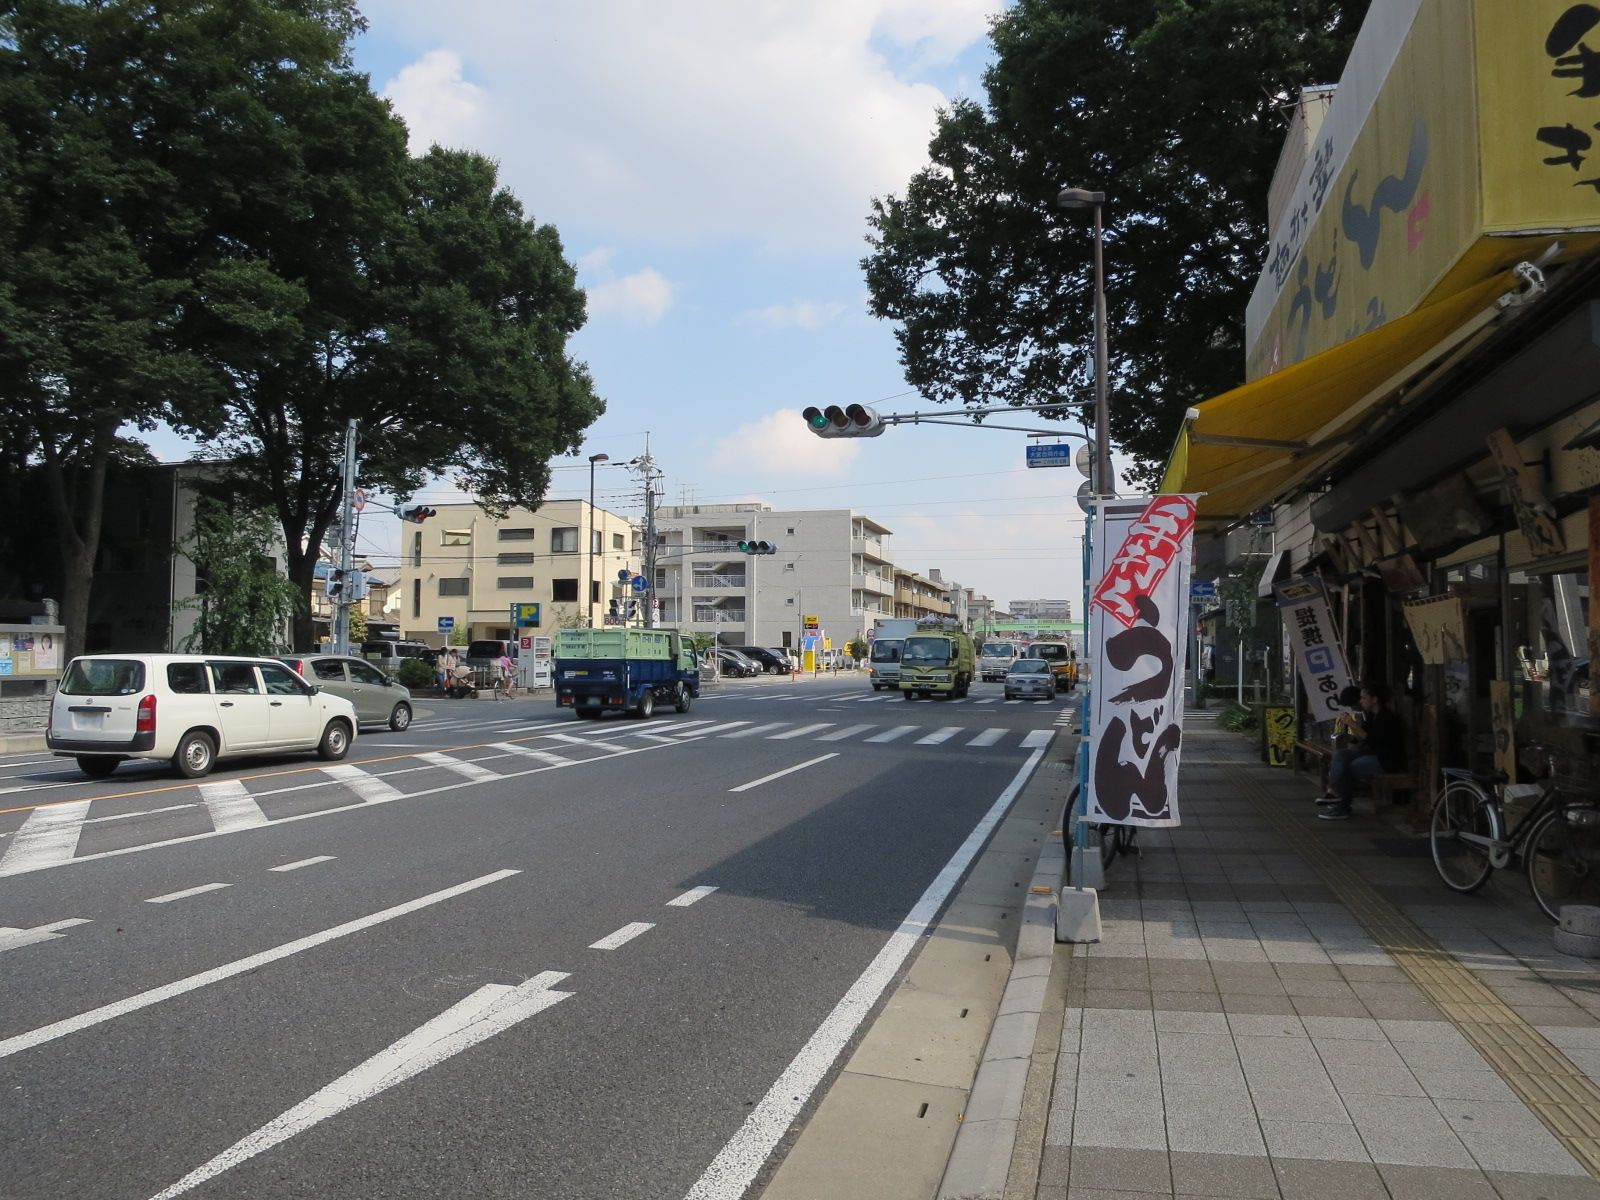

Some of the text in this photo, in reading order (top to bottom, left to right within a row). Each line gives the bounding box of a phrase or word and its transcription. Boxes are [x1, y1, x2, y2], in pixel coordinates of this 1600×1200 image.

[1101, 502, 1190, 619] 手打ち
[1094, 595, 1182, 821] うどん
